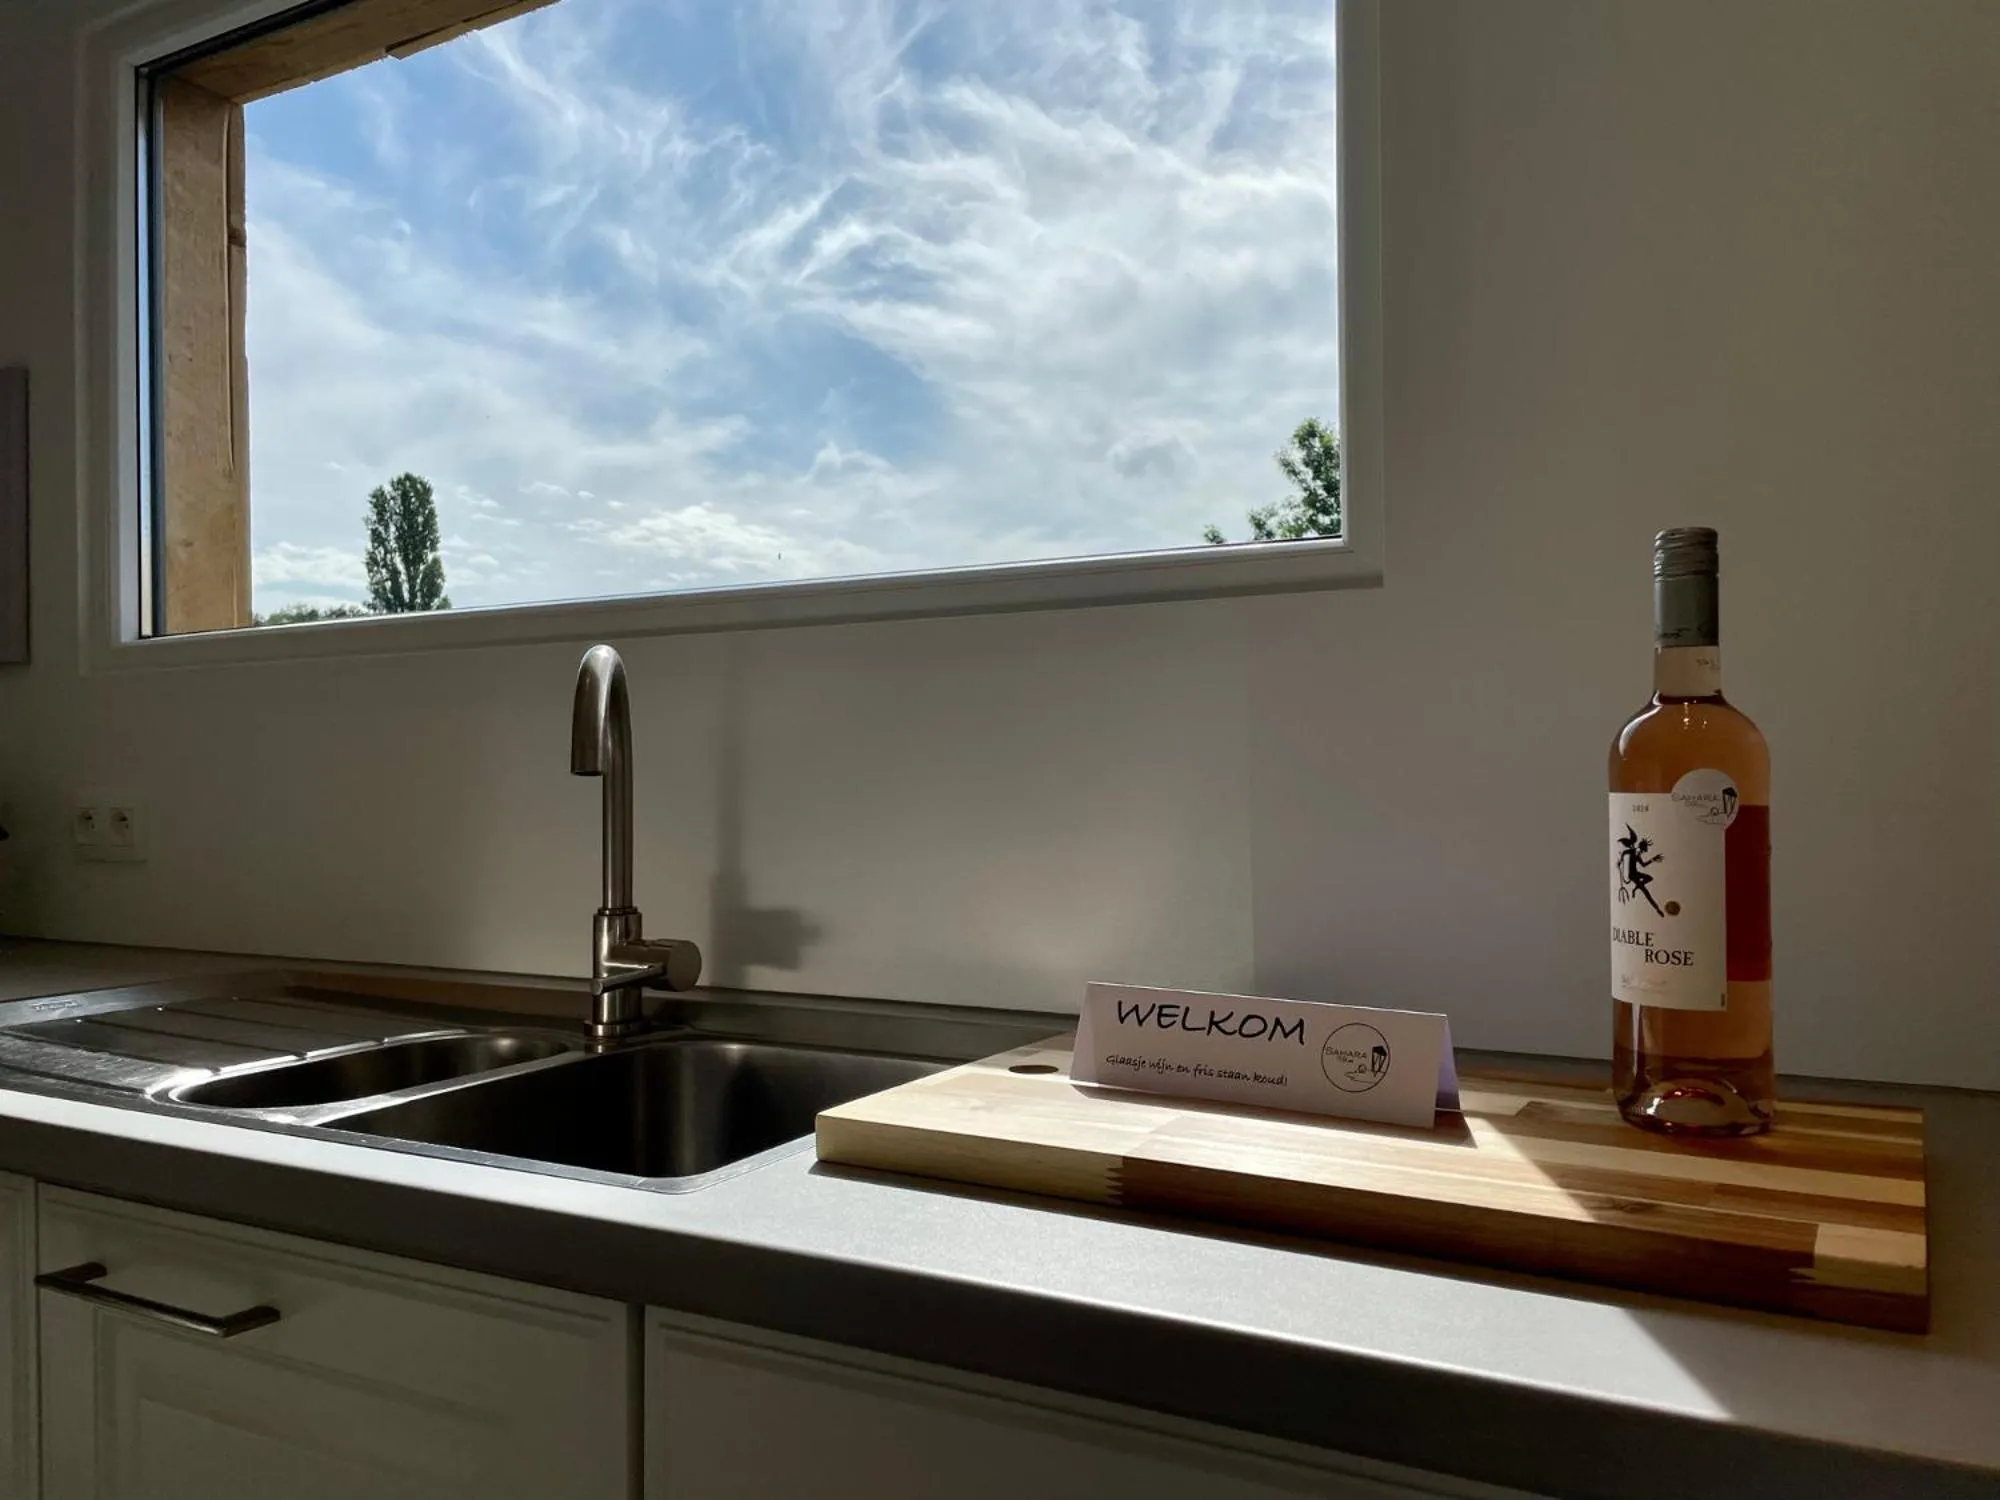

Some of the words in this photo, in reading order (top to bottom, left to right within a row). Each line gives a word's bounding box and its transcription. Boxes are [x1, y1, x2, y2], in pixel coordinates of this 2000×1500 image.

[1612, 927, 1655, 947] DIABLE
[1645, 949, 1695, 966] ROSE
[1116, 1000, 1306, 1046] WELKOM
[1106, 1055, 1147, 1072] Glaasje
[1149, 1058, 1175, 1075] wijn
[1177, 1064, 1192, 1073] en
[1194, 1063, 1214, 1078] fris
[1216, 1069, 1251, 1081] staan
[1253, 1071, 1288, 1087] koud!
